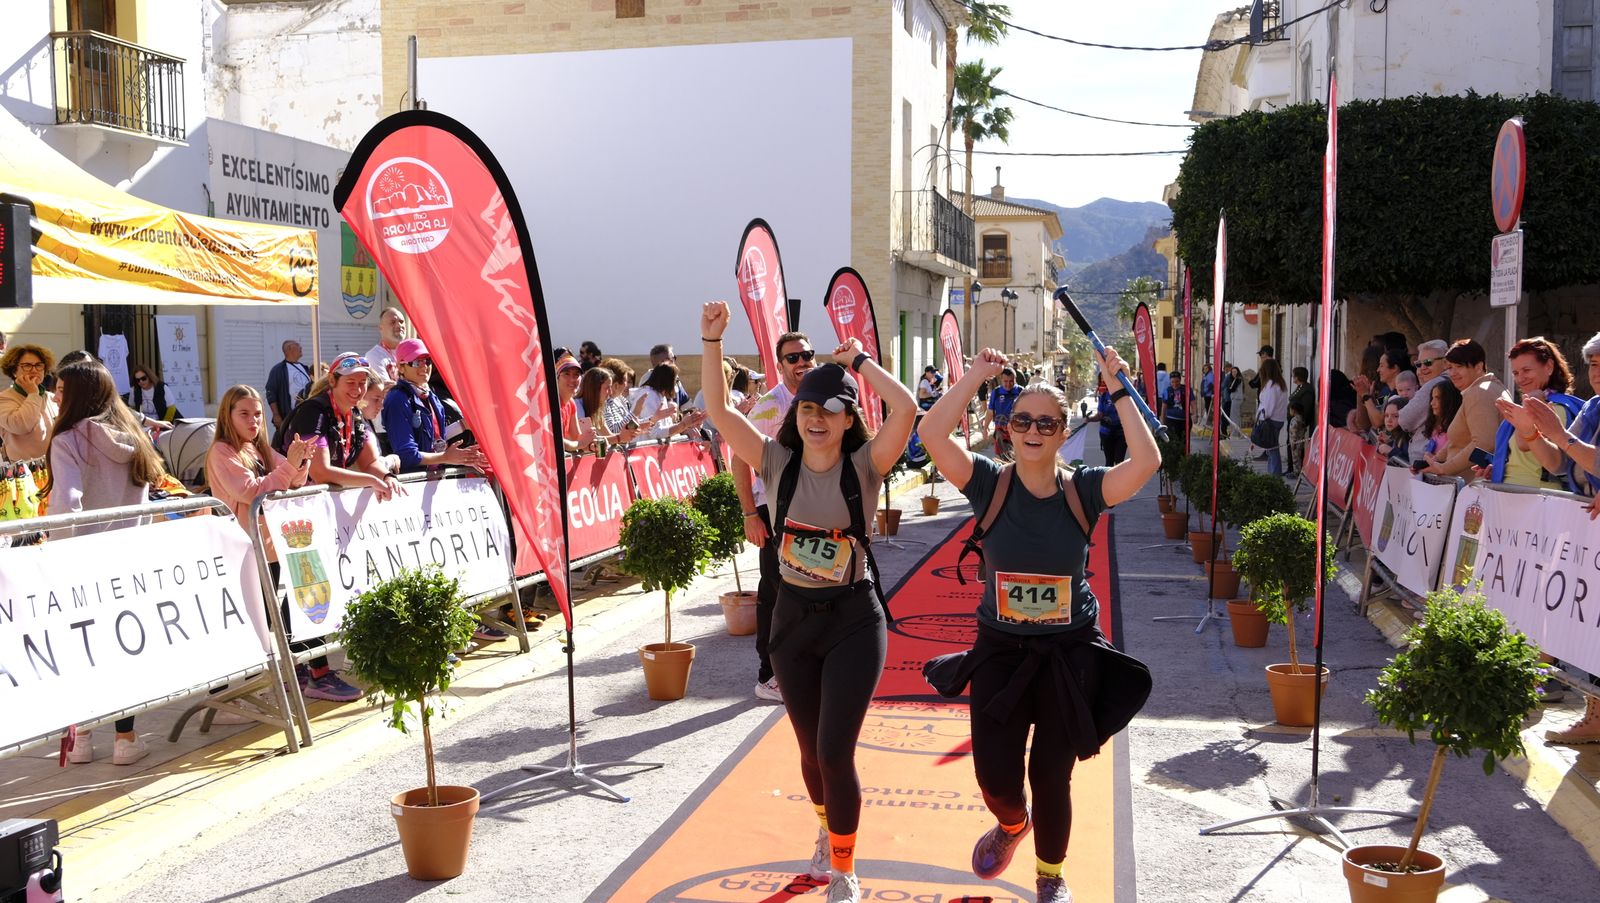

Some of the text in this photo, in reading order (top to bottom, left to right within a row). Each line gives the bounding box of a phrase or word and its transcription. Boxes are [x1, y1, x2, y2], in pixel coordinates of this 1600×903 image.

[222, 153, 330, 196] EXCELENTÍSIMO
[226, 192, 330, 229] AYUNTAMIENTO
[568, 482, 624, 529] EOLIA
[334, 505, 490, 545] AYUNTAMIENTO DE
[338, 527, 500, 591] CANTORIA
[793, 536, 838, 560] 415
[197, 555, 227, 581] DE
[1008, 585, 1057, 604] 414
